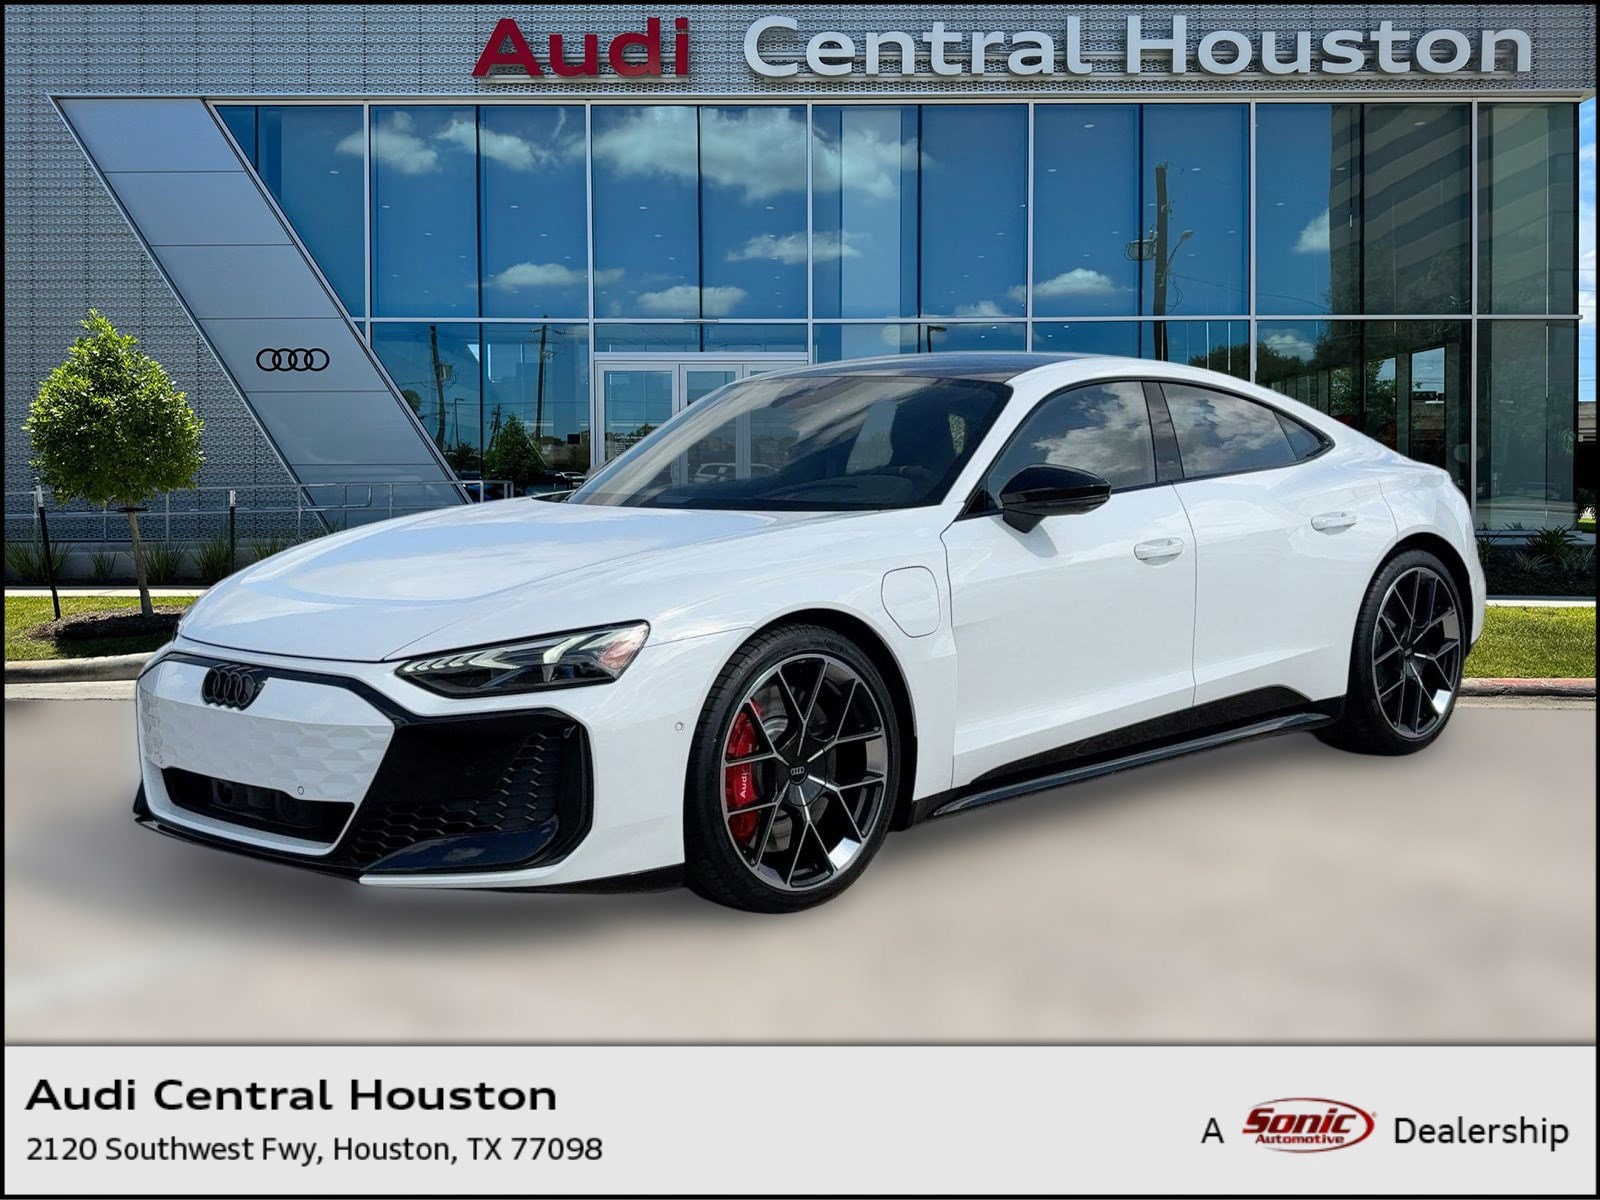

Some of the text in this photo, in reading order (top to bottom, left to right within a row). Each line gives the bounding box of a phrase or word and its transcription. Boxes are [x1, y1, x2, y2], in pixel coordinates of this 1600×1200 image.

[472, 15, 1533, 78] Audi Central Houston
[740, 769, 748, 799] Audi
